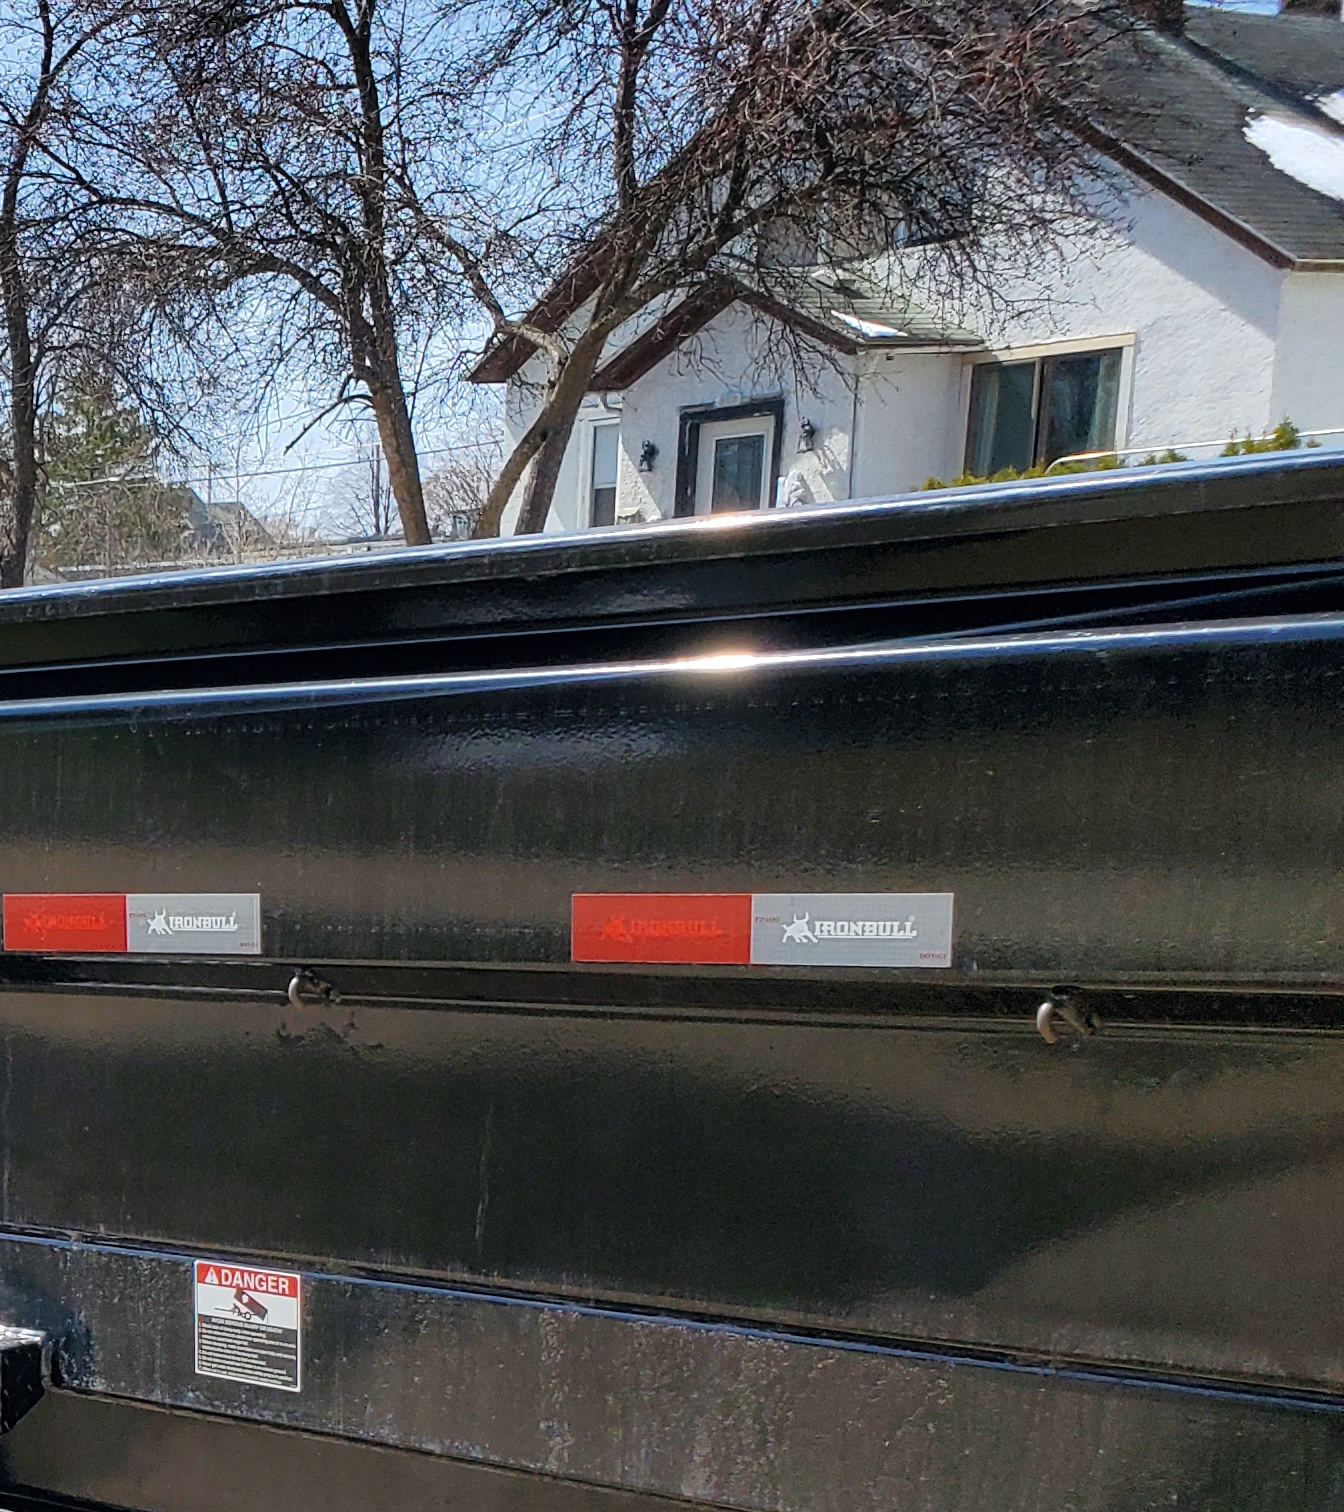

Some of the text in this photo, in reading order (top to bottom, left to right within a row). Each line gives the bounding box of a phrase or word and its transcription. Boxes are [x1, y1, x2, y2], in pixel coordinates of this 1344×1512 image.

[168, 915, 238, 931] IRONBULL
[814, 920, 918, 938] IRONBULL
[220, 1268, 289, 1295] DANGER
